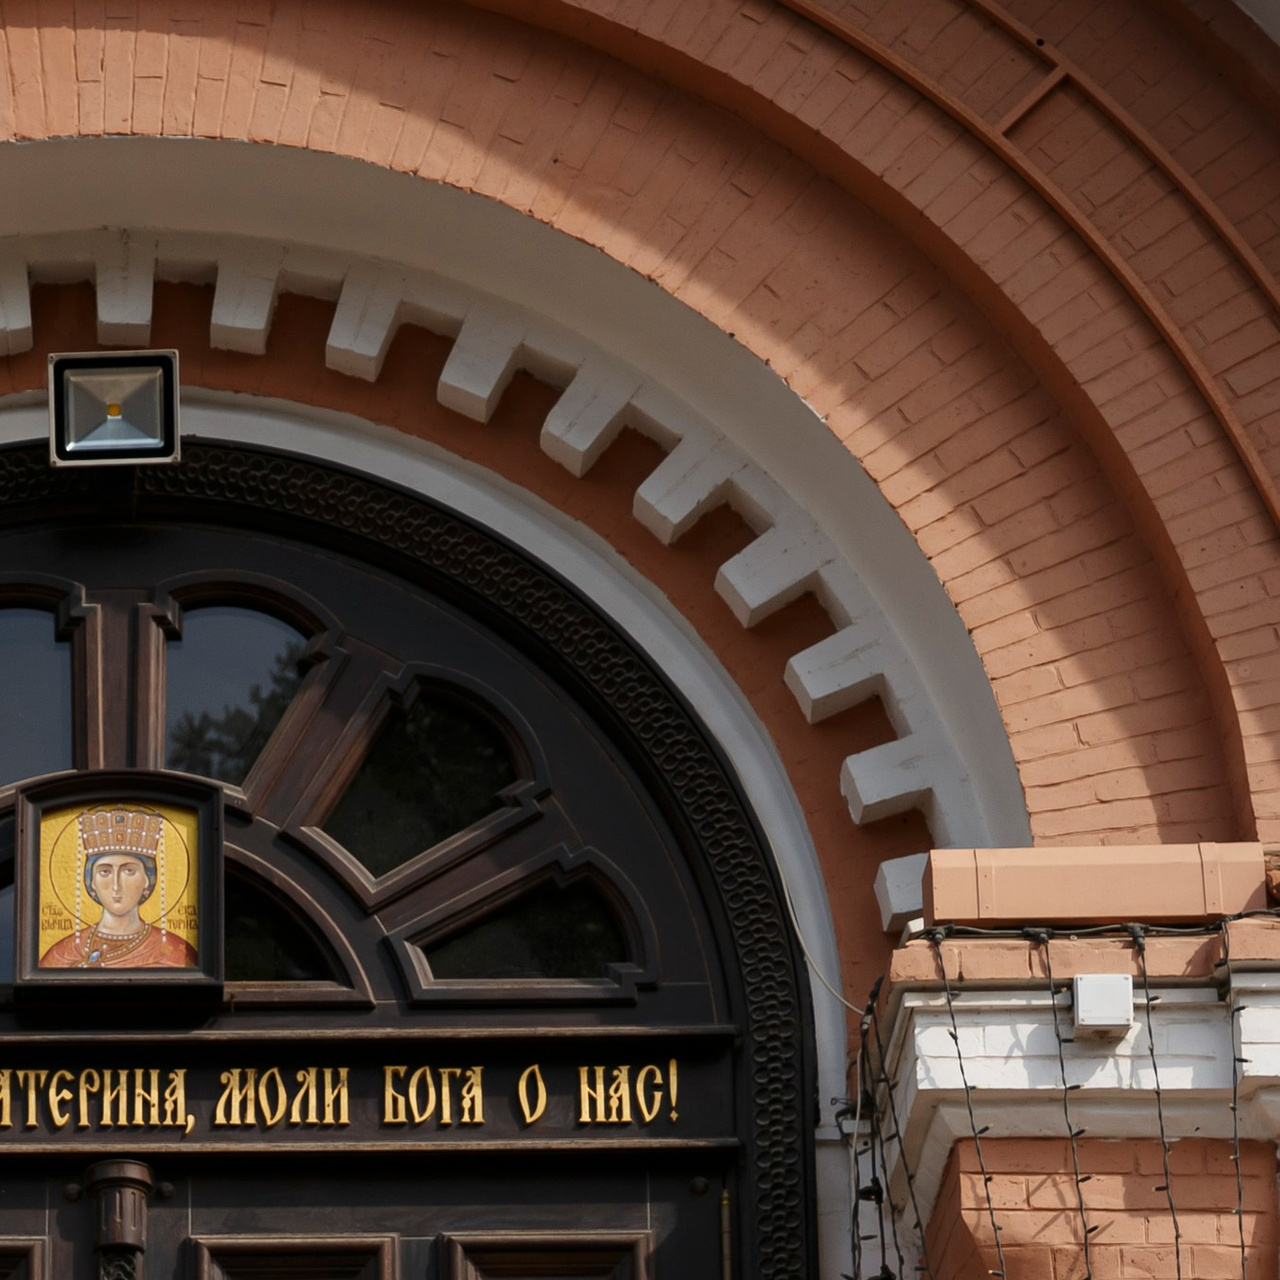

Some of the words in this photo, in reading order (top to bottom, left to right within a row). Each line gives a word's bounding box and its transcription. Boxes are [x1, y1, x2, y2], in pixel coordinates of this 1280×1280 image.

[214, 1067, 351, 1125] МОЛИ
[383, 1065, 486, 1124] БОГА
[518, 1063, 548, 1124] О
[578, 1058, 679, 1123] НАС!
